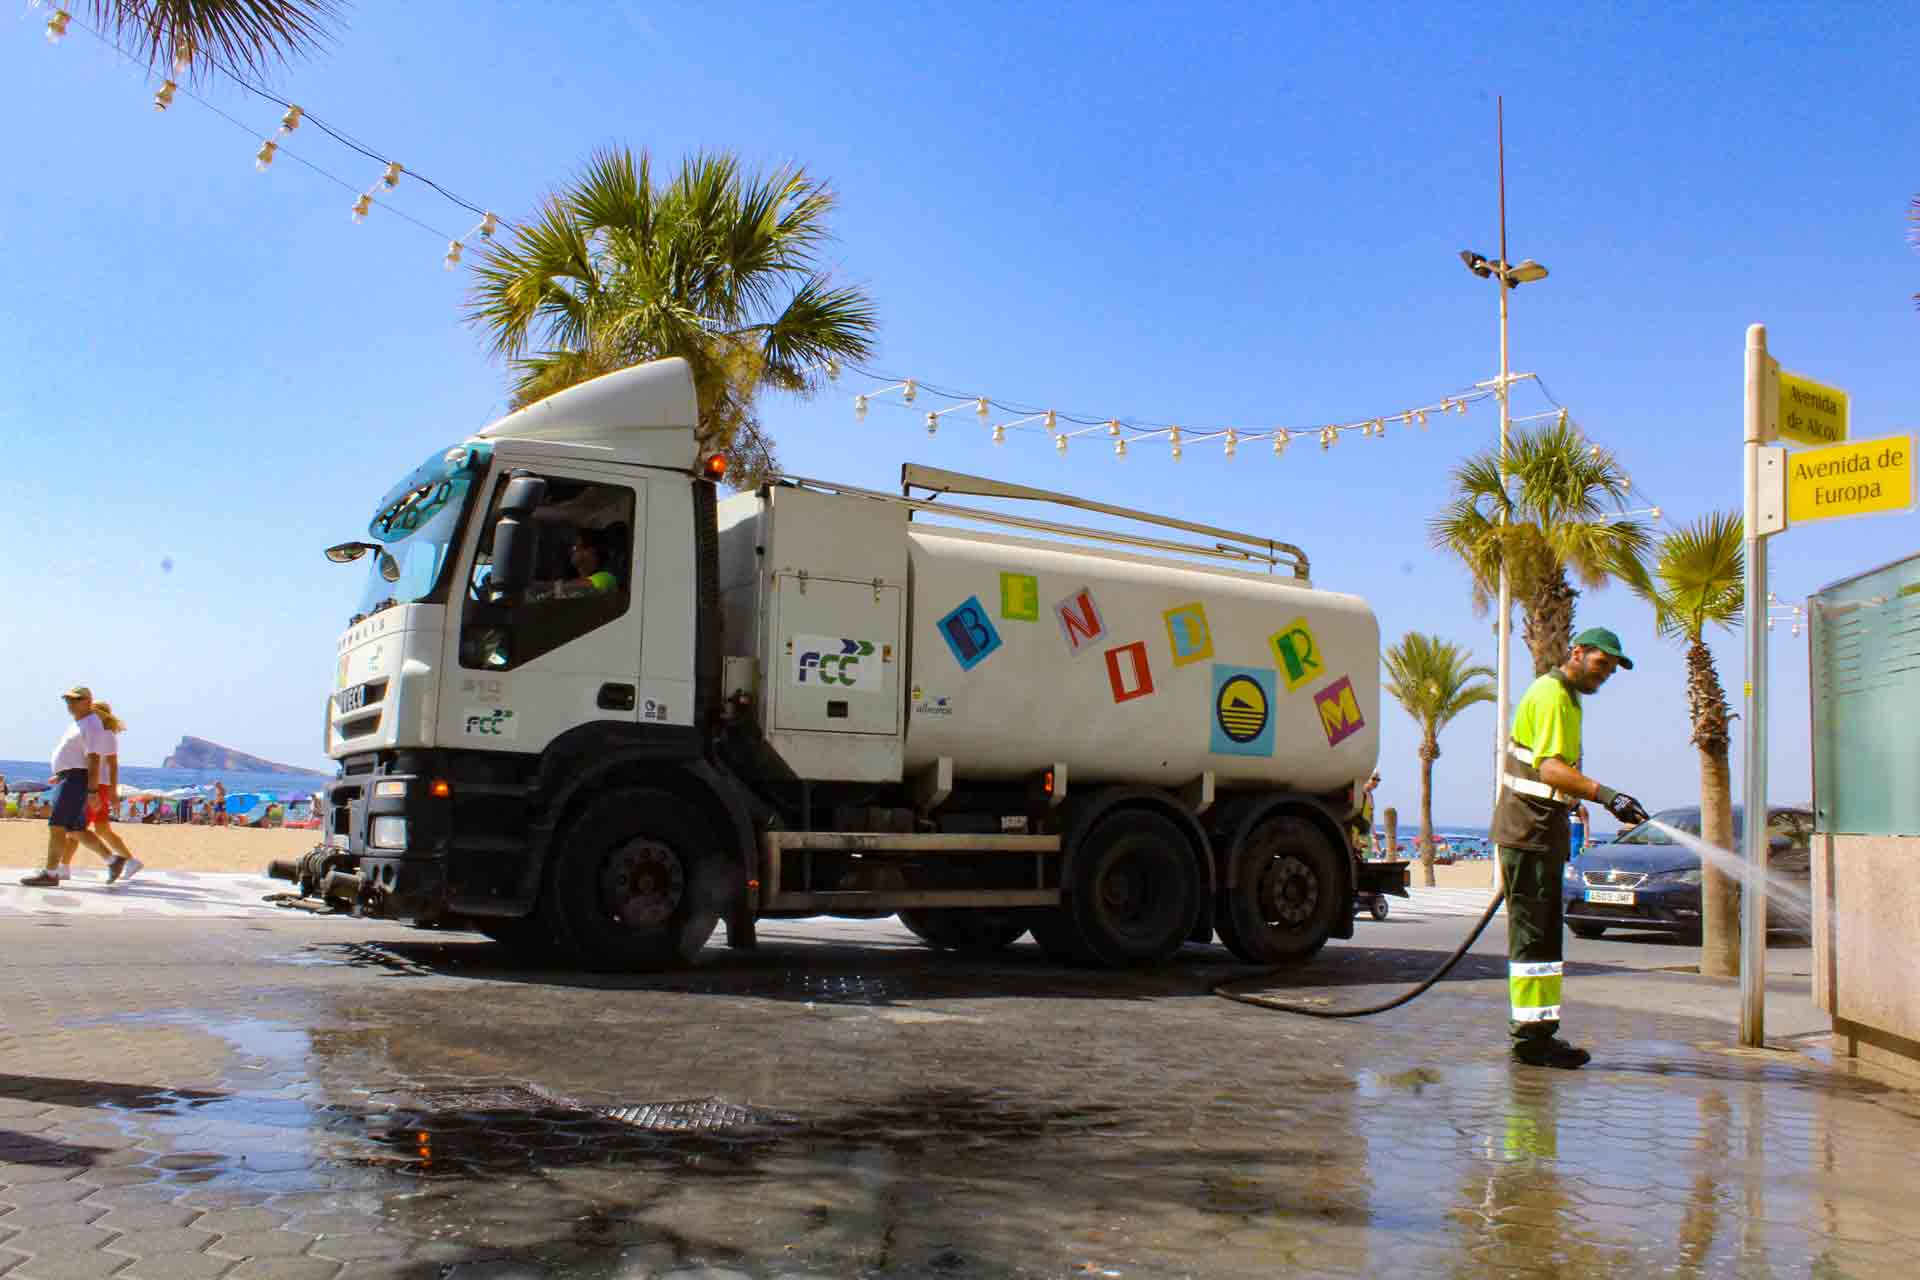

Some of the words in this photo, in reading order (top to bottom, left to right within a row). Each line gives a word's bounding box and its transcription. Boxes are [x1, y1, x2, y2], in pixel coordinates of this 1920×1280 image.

[1791, 385, 1837, 416] Avenida
[1786, 410, 1803, 431] de
[1796, 454, 1871, 480] Avenida
[1877, 447, 1903, 469] de
[1815, 481, 1882, 506] Europa
[799, 652, 860, 686] FCC
[466, 716, 504, 735] FCC
